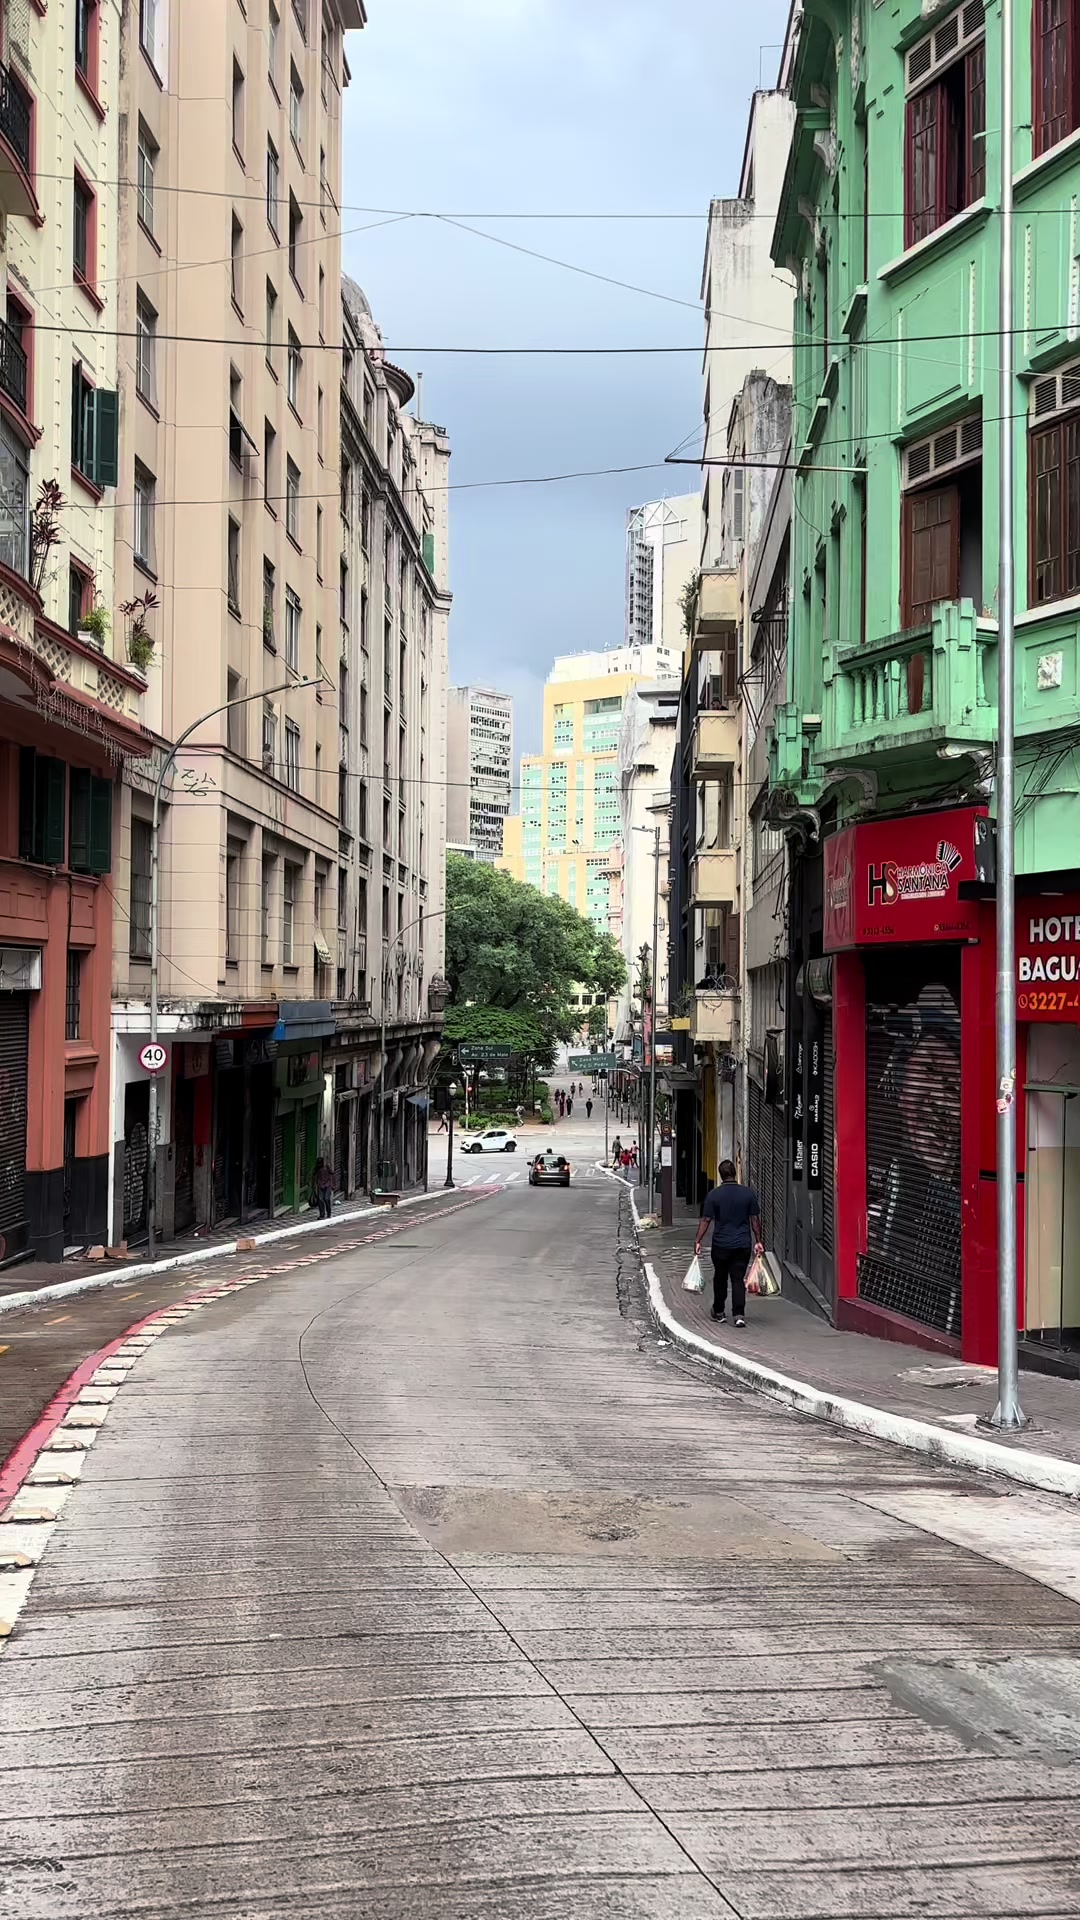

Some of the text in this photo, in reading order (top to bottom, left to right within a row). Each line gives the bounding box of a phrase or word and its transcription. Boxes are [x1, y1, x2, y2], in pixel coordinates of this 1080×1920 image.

[898, 873, 949, 893] SANTANA
[143, 1049, 163, 1061] 40
[811, 1143, 819, 1177] CASIO
